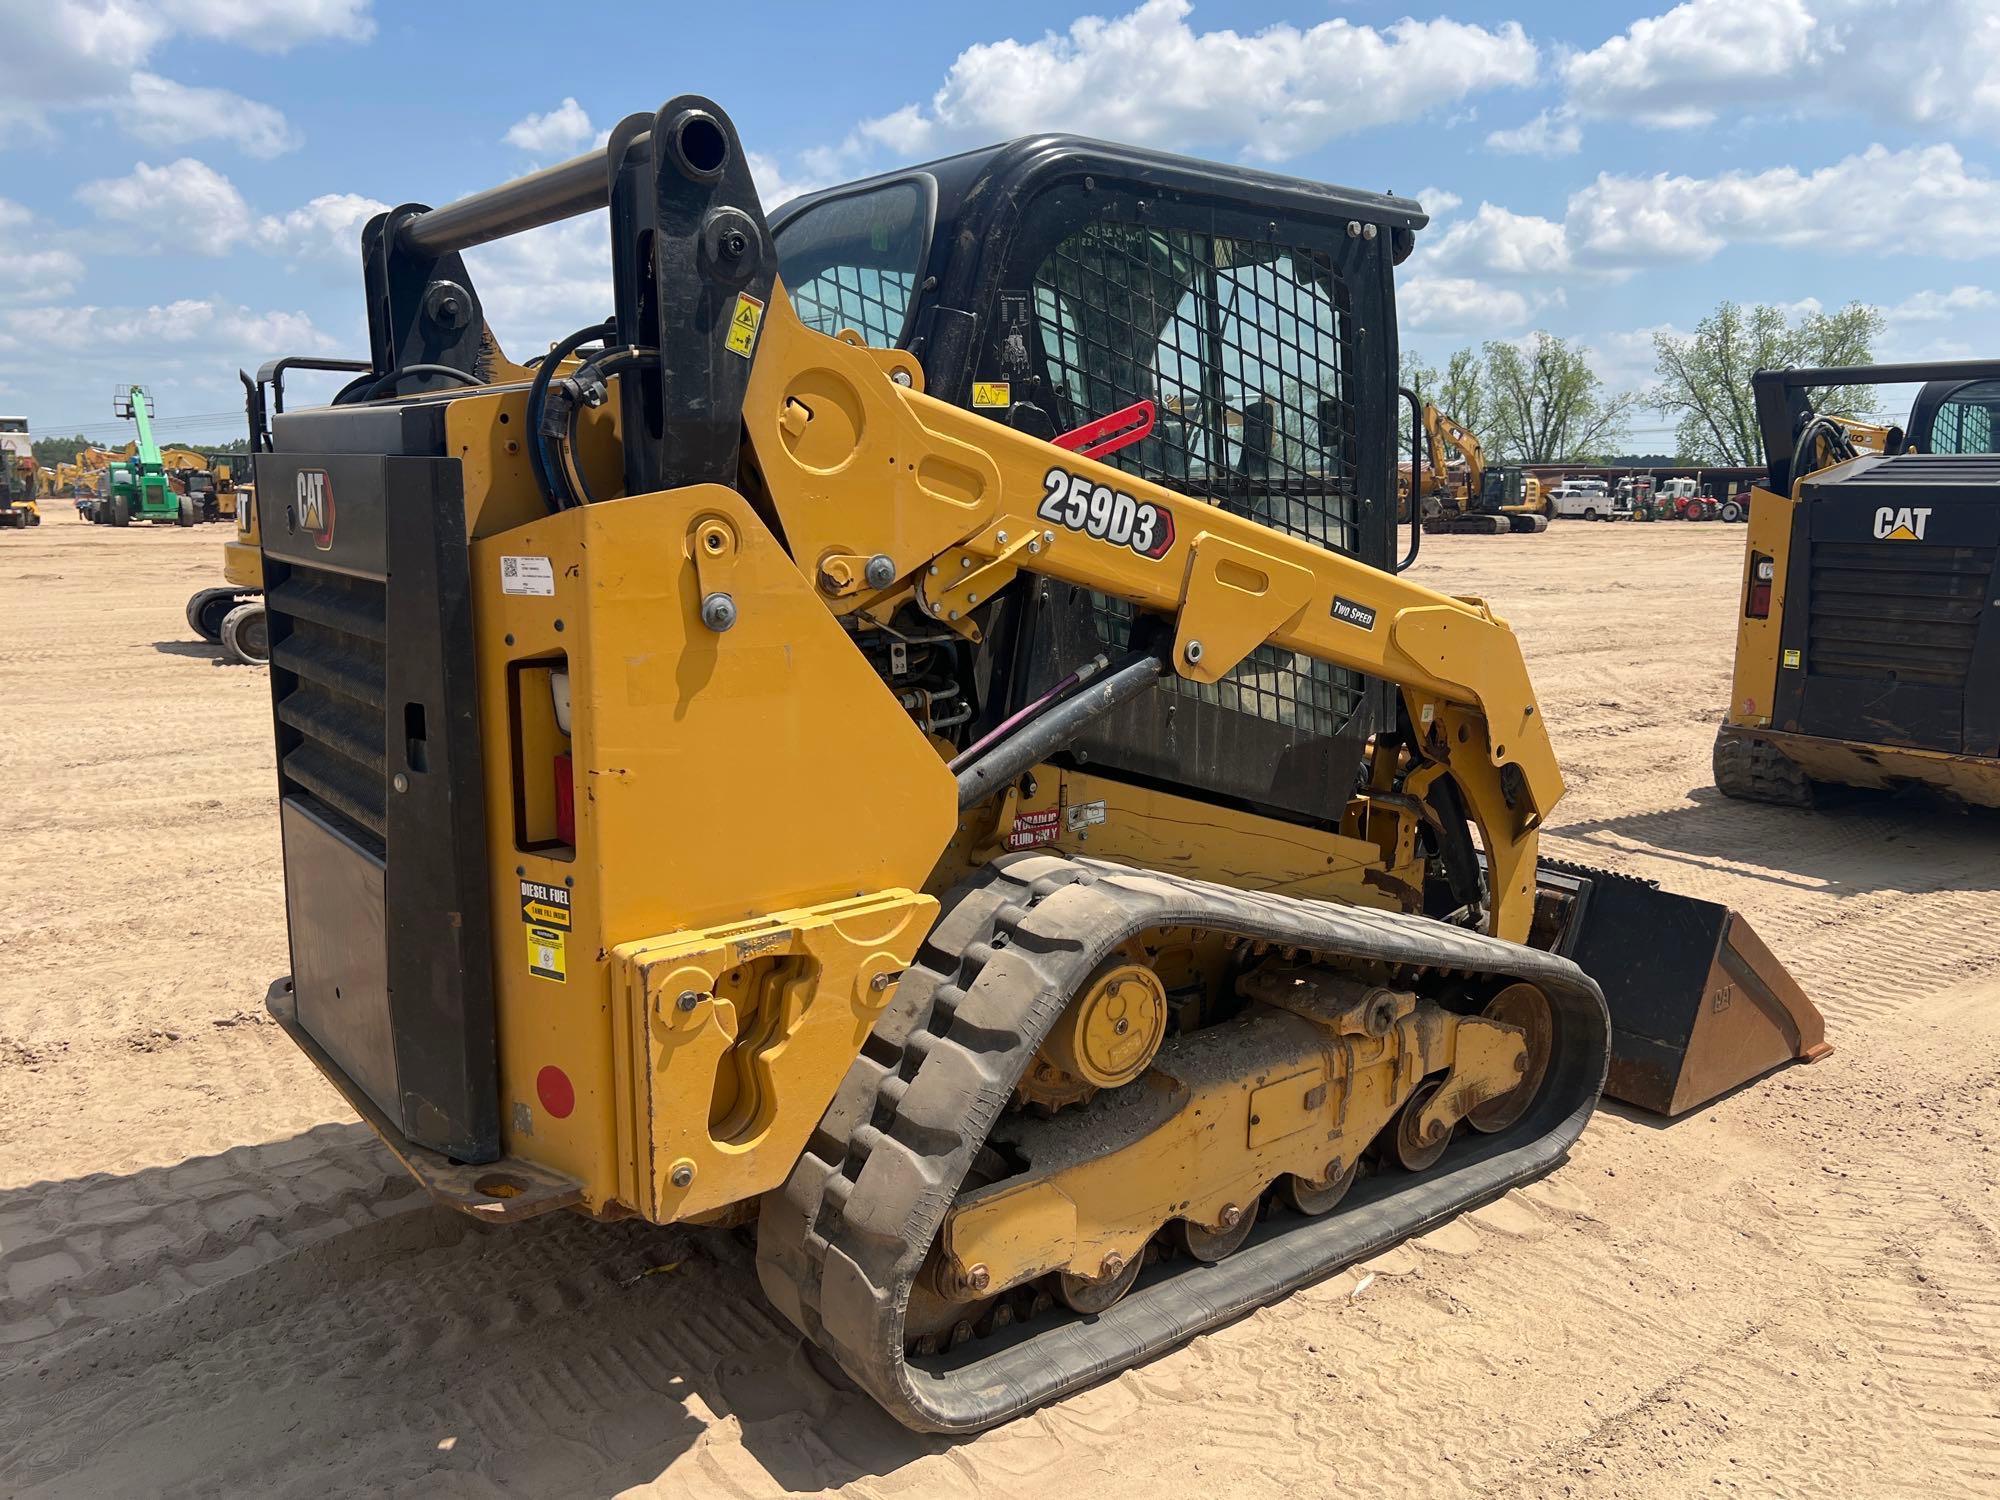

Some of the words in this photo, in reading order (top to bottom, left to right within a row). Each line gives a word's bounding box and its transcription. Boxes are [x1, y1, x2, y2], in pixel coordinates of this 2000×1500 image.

[297, 472, 324, 529] CAT
[1039, 469, 1157, 552] 259D3
[1873, 506, 1932, 541] CAT
[1010, 832, 1034, 846] FLUID
[521, 882, 548, 901] DIESEL
[549, 888, 569, 905] FUEL
